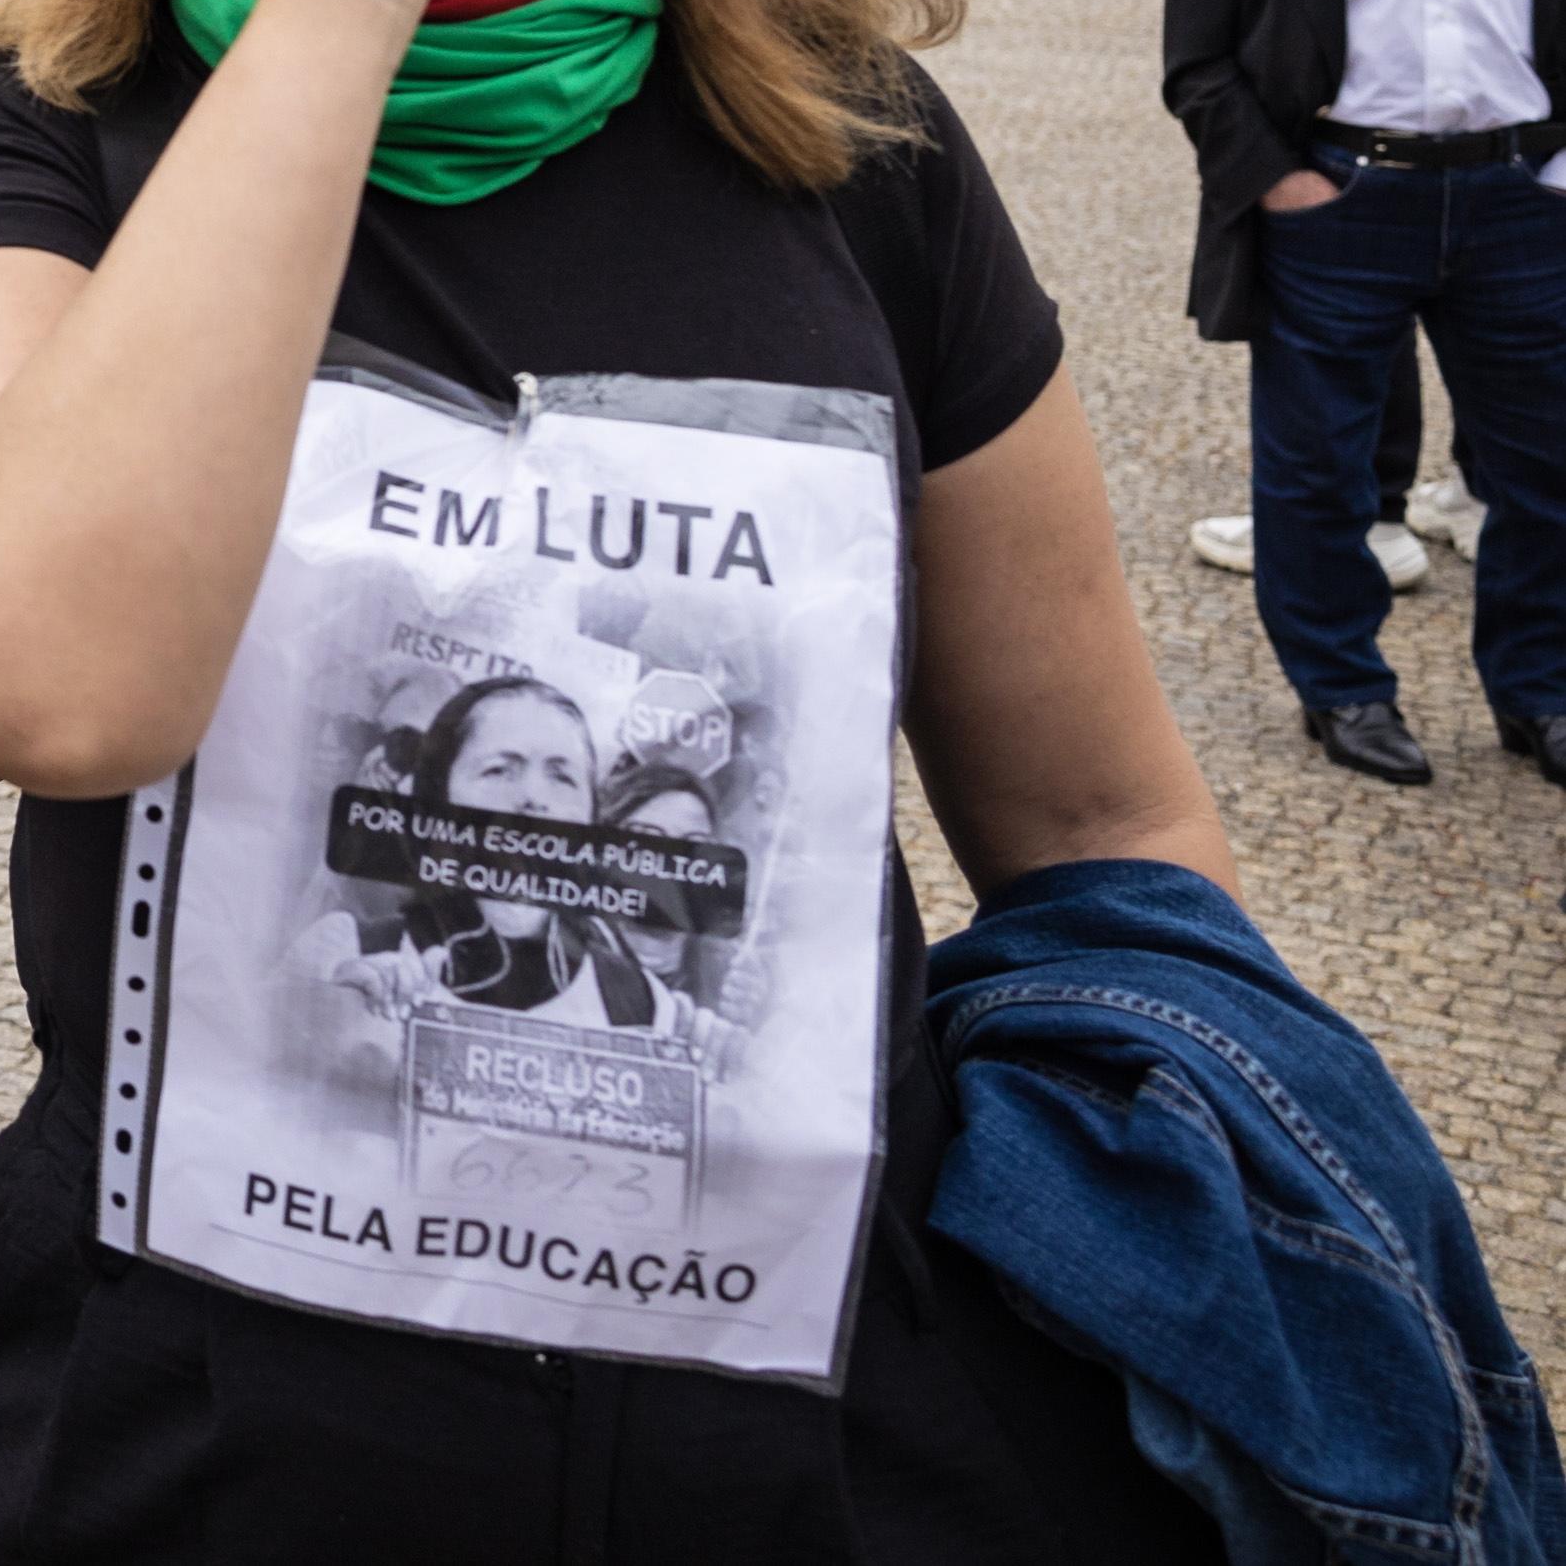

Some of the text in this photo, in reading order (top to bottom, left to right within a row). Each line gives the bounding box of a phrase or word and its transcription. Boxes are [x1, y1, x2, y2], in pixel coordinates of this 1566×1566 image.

[368, 469, 774, 588] EM LUTA
[627, 700, 726, 752] STOP
[348, 801, 728, 889] POR UMA ESCOLA PÚBLICA
[418, 856, 648, 918] DE QUALIDADE!
[464, 1043, 645, 1107] RECLUSO
[243, 1172, 758, 1304] PELA EDUCAÇÃO
